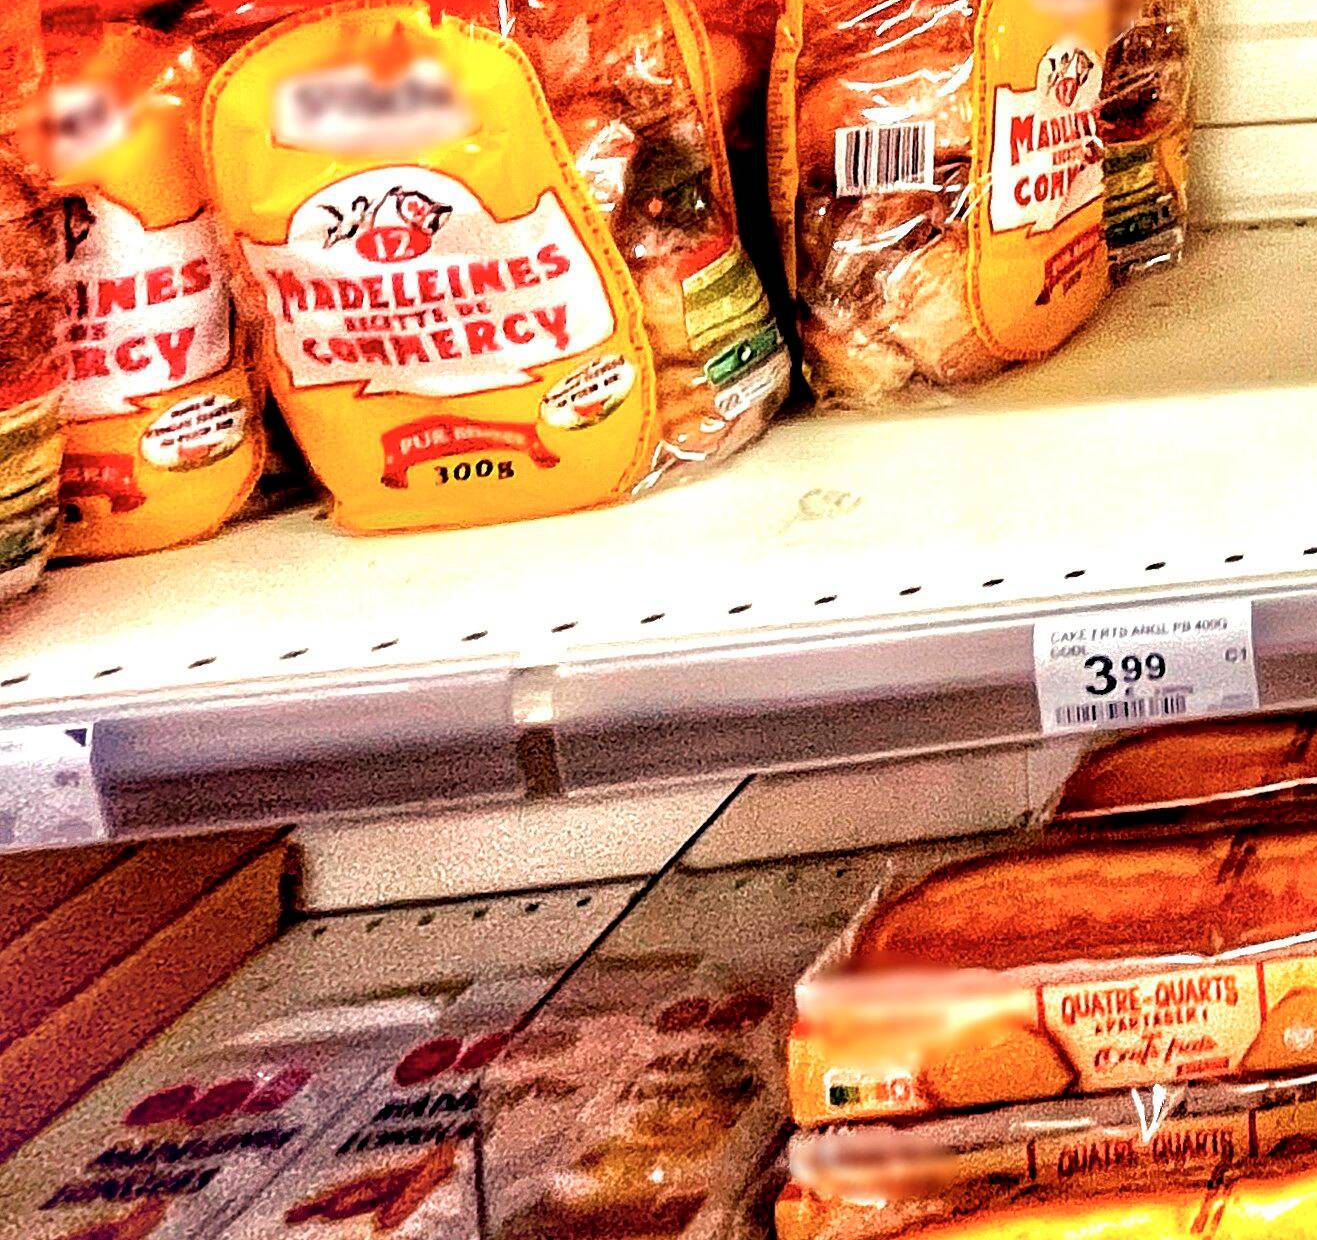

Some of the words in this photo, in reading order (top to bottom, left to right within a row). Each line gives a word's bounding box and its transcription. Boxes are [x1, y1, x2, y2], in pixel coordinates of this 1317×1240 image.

[374, 230, 415, 259] 12
[266, 243, 571, 324] MADELEINES
[302, 304, 571, 365] COMMERCY
